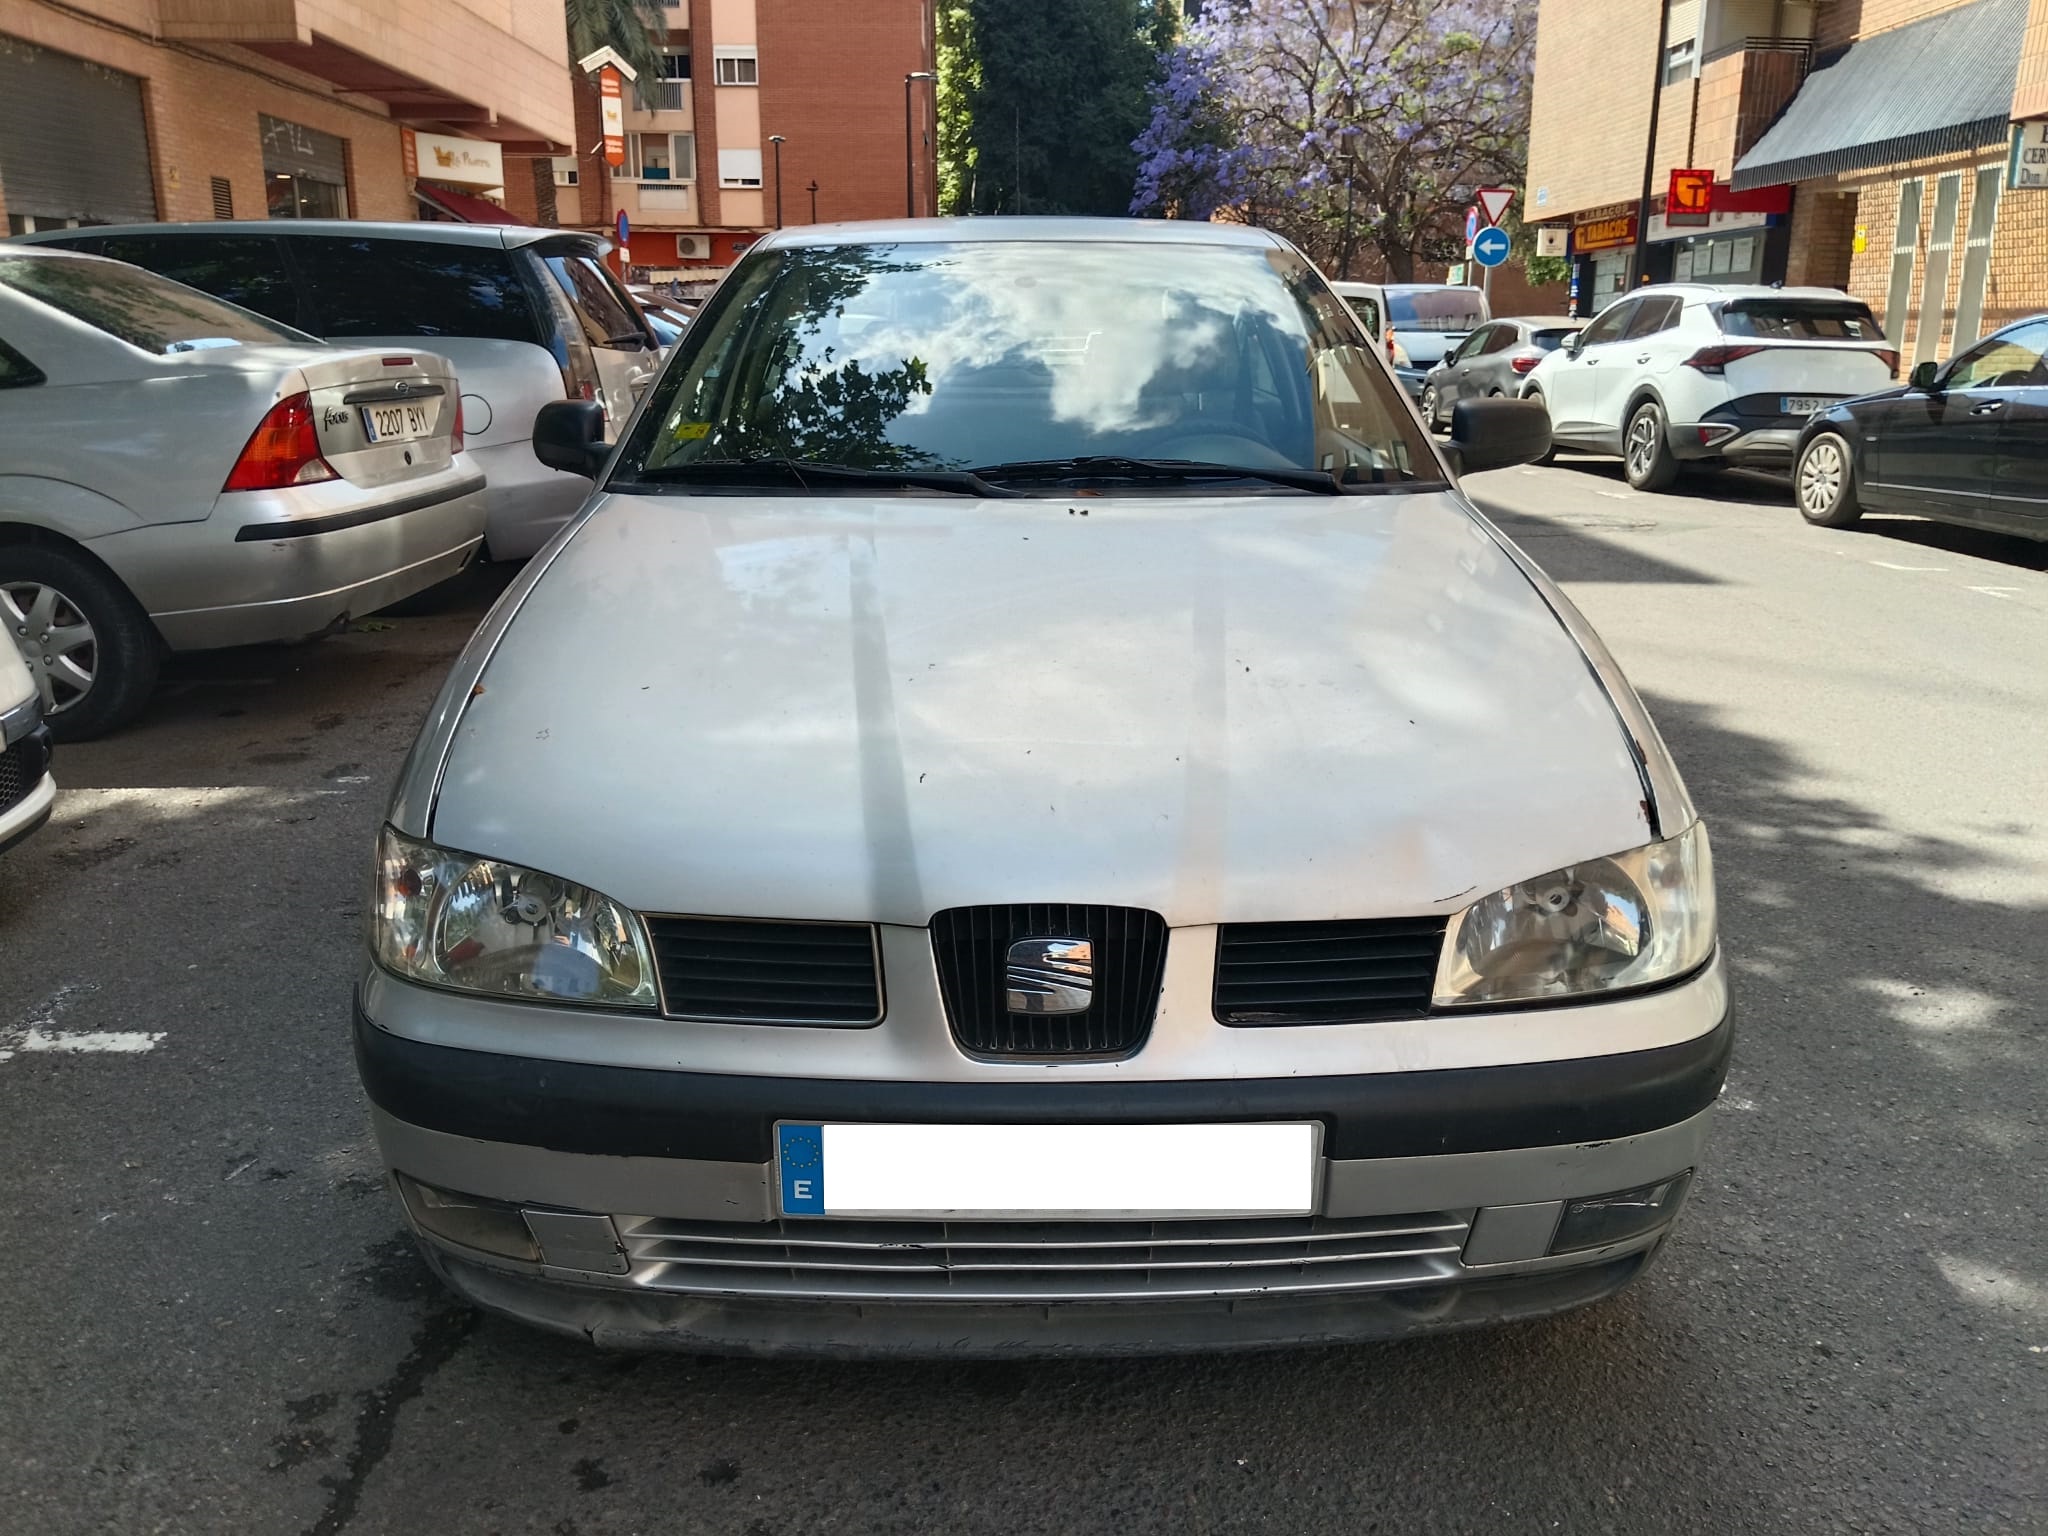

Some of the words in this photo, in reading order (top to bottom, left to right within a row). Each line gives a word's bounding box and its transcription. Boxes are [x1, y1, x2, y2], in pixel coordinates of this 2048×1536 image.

[1586, 218, 1629, 242] TABACOS
[376, 408, 405, 437] 2207
[407, 406, 429, 432] BYY
[793, 1180, 812, 1199] E
